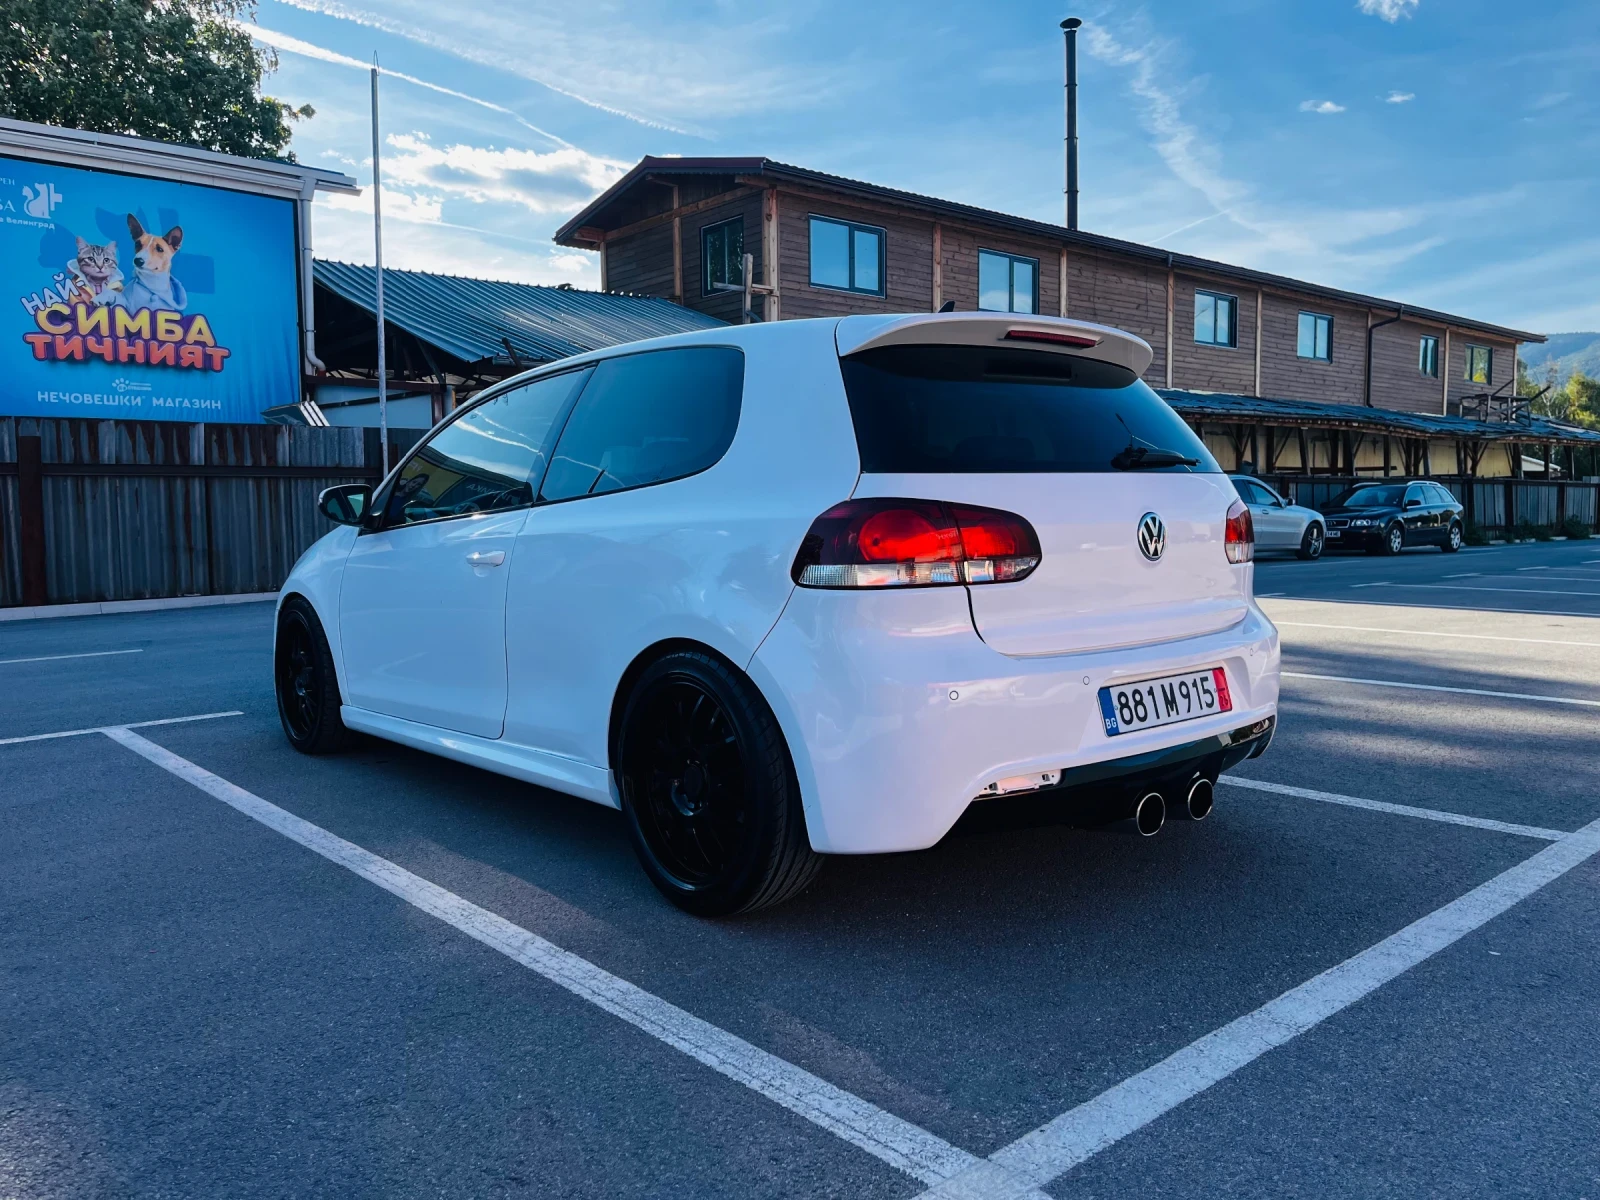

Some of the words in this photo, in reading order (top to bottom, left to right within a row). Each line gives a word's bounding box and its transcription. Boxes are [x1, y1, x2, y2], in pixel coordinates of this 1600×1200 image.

[35, 303, 216, 347] СИМБА
[24, 333, 230, 372] ТИЧНИЯТ
[37, 391, 142, 407] НЕЧОВЕШКИ
[152, 396, 222, 410] МАГАЗИН
[1117, 676, 1215, 726] 881M915
[1105, 718, 1117, 729] BG
